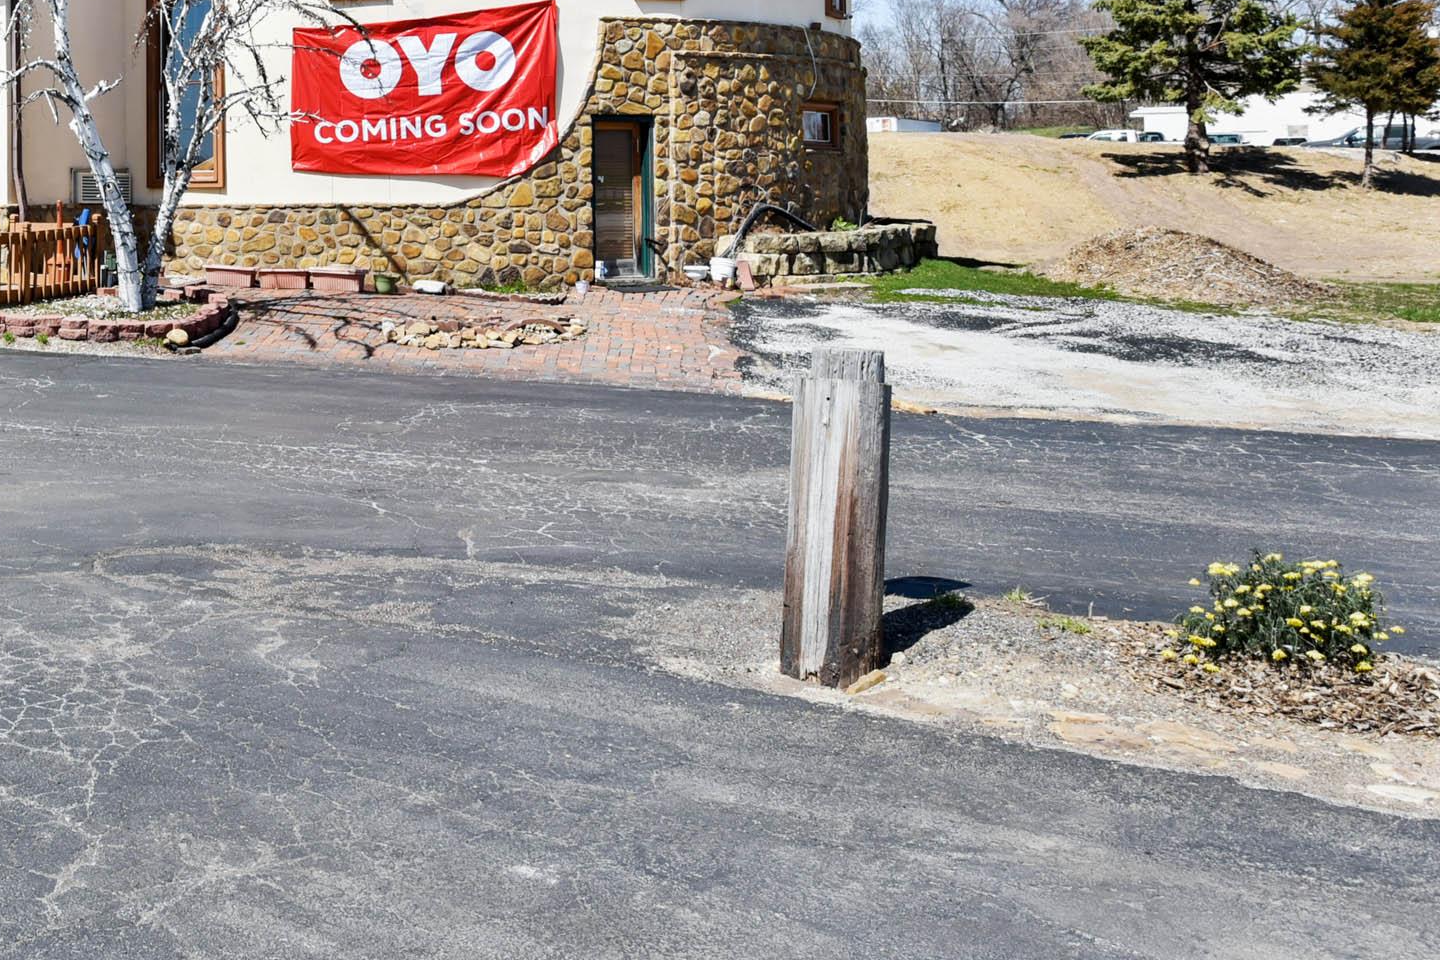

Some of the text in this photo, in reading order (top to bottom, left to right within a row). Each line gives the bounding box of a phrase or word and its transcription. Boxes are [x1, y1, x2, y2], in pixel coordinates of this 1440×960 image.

[339, 31, 517, 99] OYO
[314, 106, 549, 144] COMING SOON
